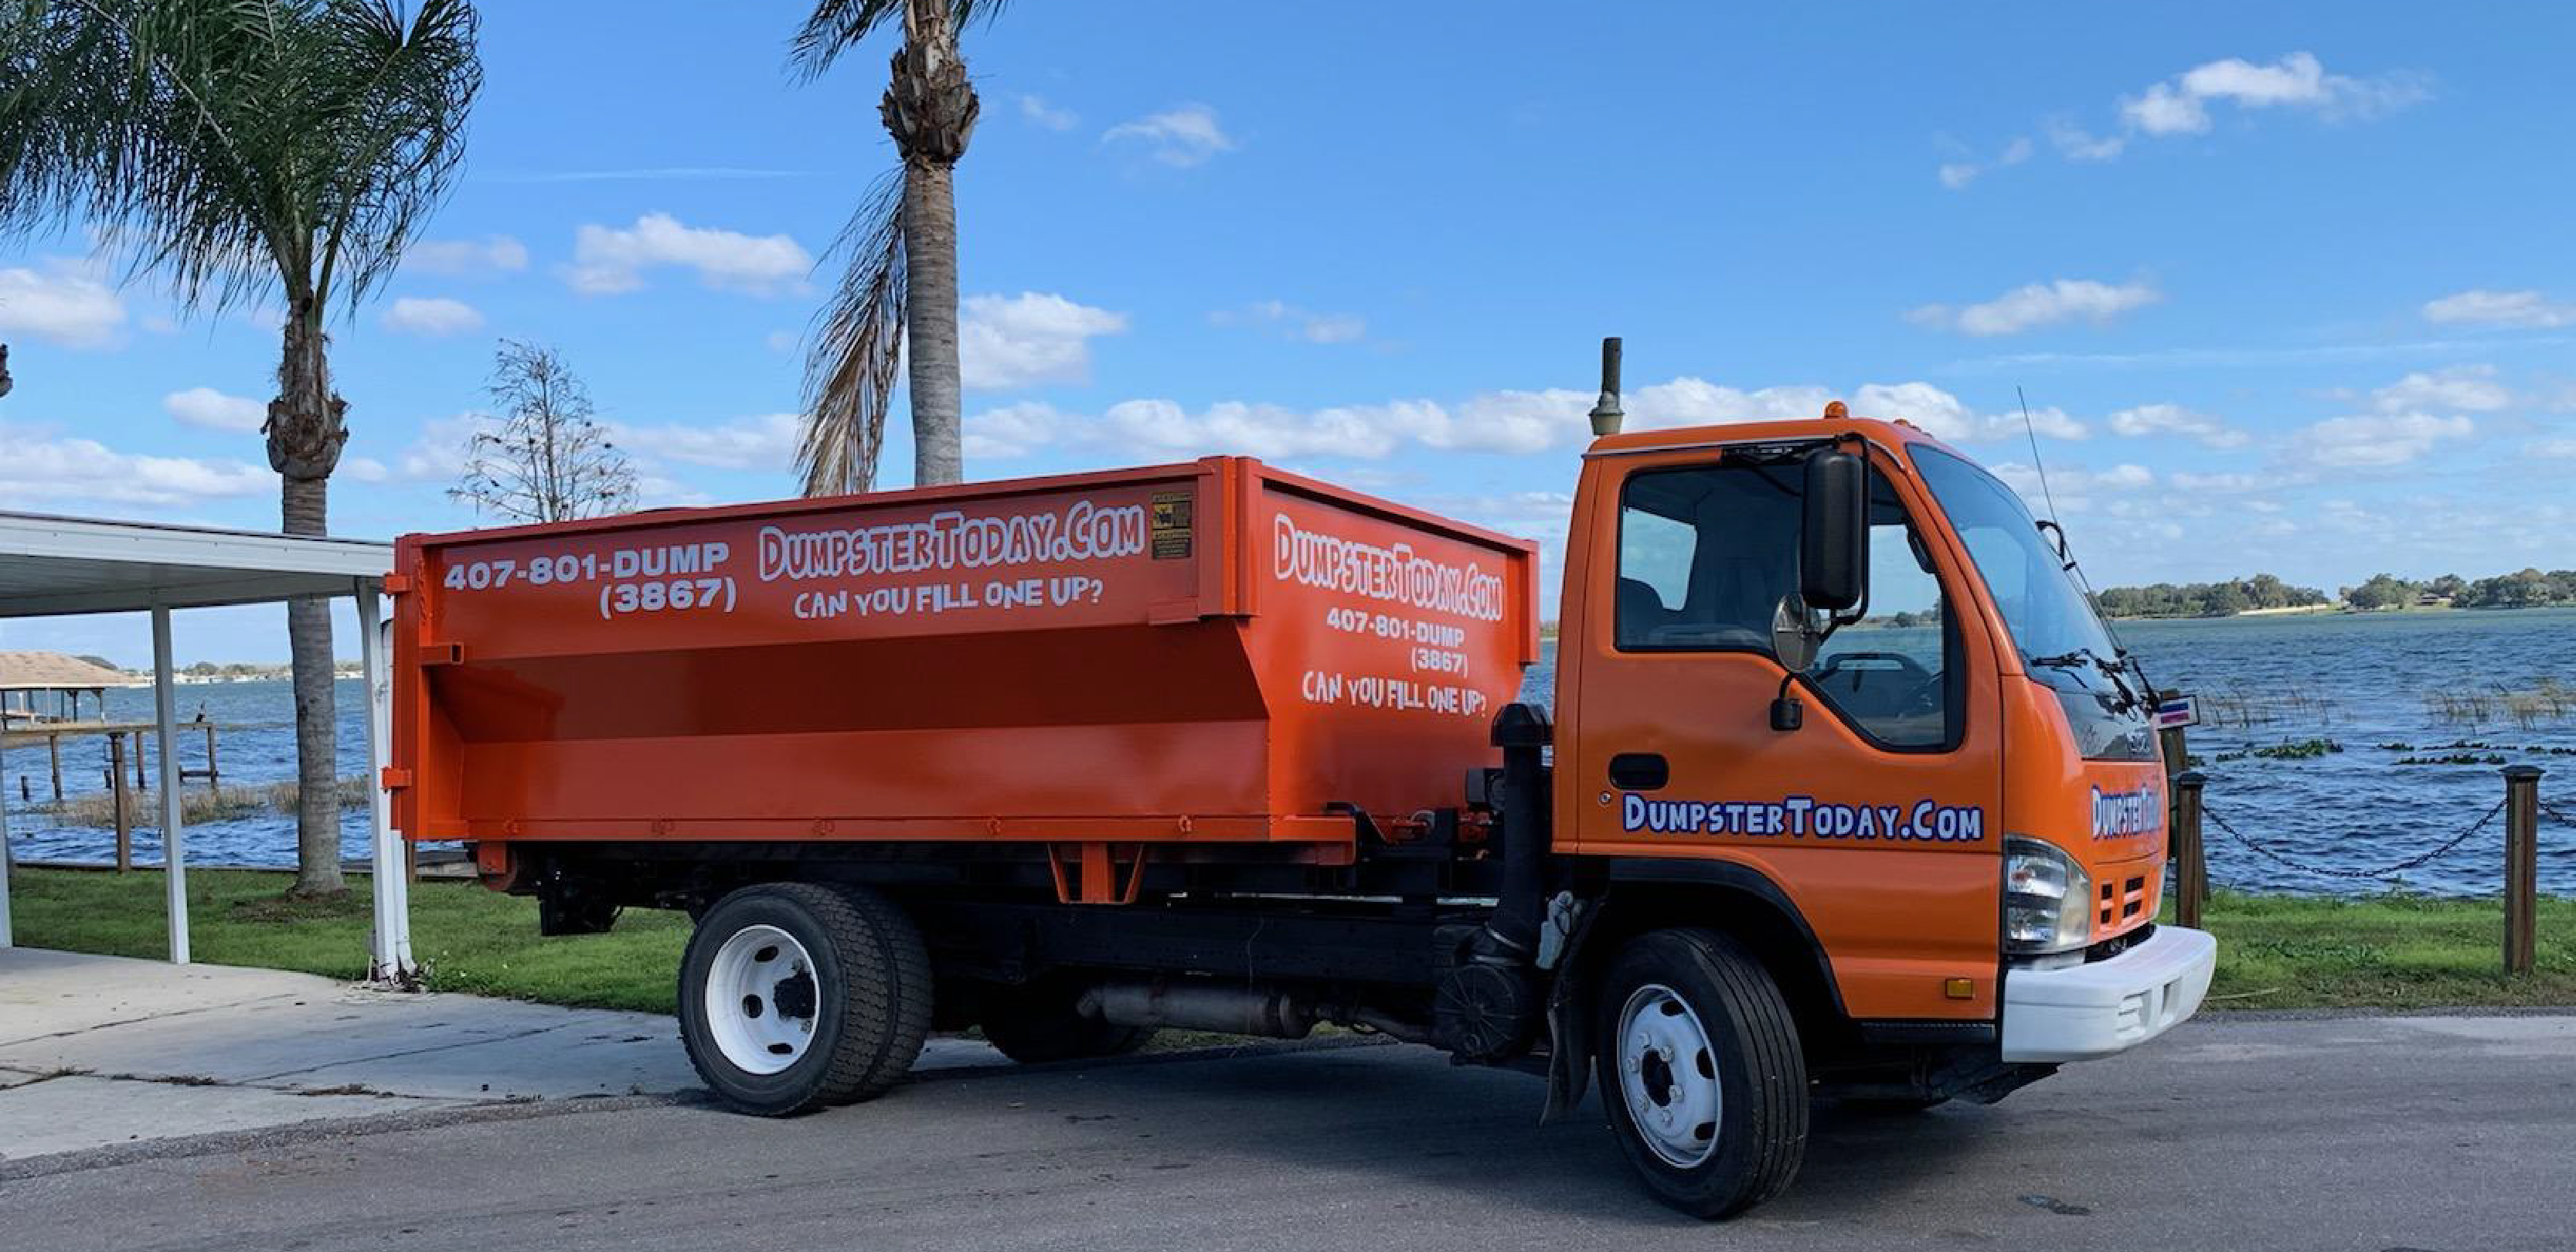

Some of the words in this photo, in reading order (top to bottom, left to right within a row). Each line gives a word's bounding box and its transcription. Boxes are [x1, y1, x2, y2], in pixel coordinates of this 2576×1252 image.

[444, 543, 729, 590] 407-801-DUMP
[600, 577, 737, 618] (3867)
[795, 590, 848, 619] CAN
[854, 587, 910, 615] YOU
[916, 583, 980, 612] FILL
[985, 580, 1043, 610] ONE
[1050, 577, 1104, 607] UP?
[1327, 607, 1465, 648] 407-801-DUMP
[1411, 648, 1468, 679] (3867)
[1302, 671, 1342, 703] CAN
[1347, 676, 1384, 707] YOU
[1388, 679, 1424, 710] FILL
[1428, 686, 1459, 713] ONE
[1462, 688, 1486, 717] UP?
